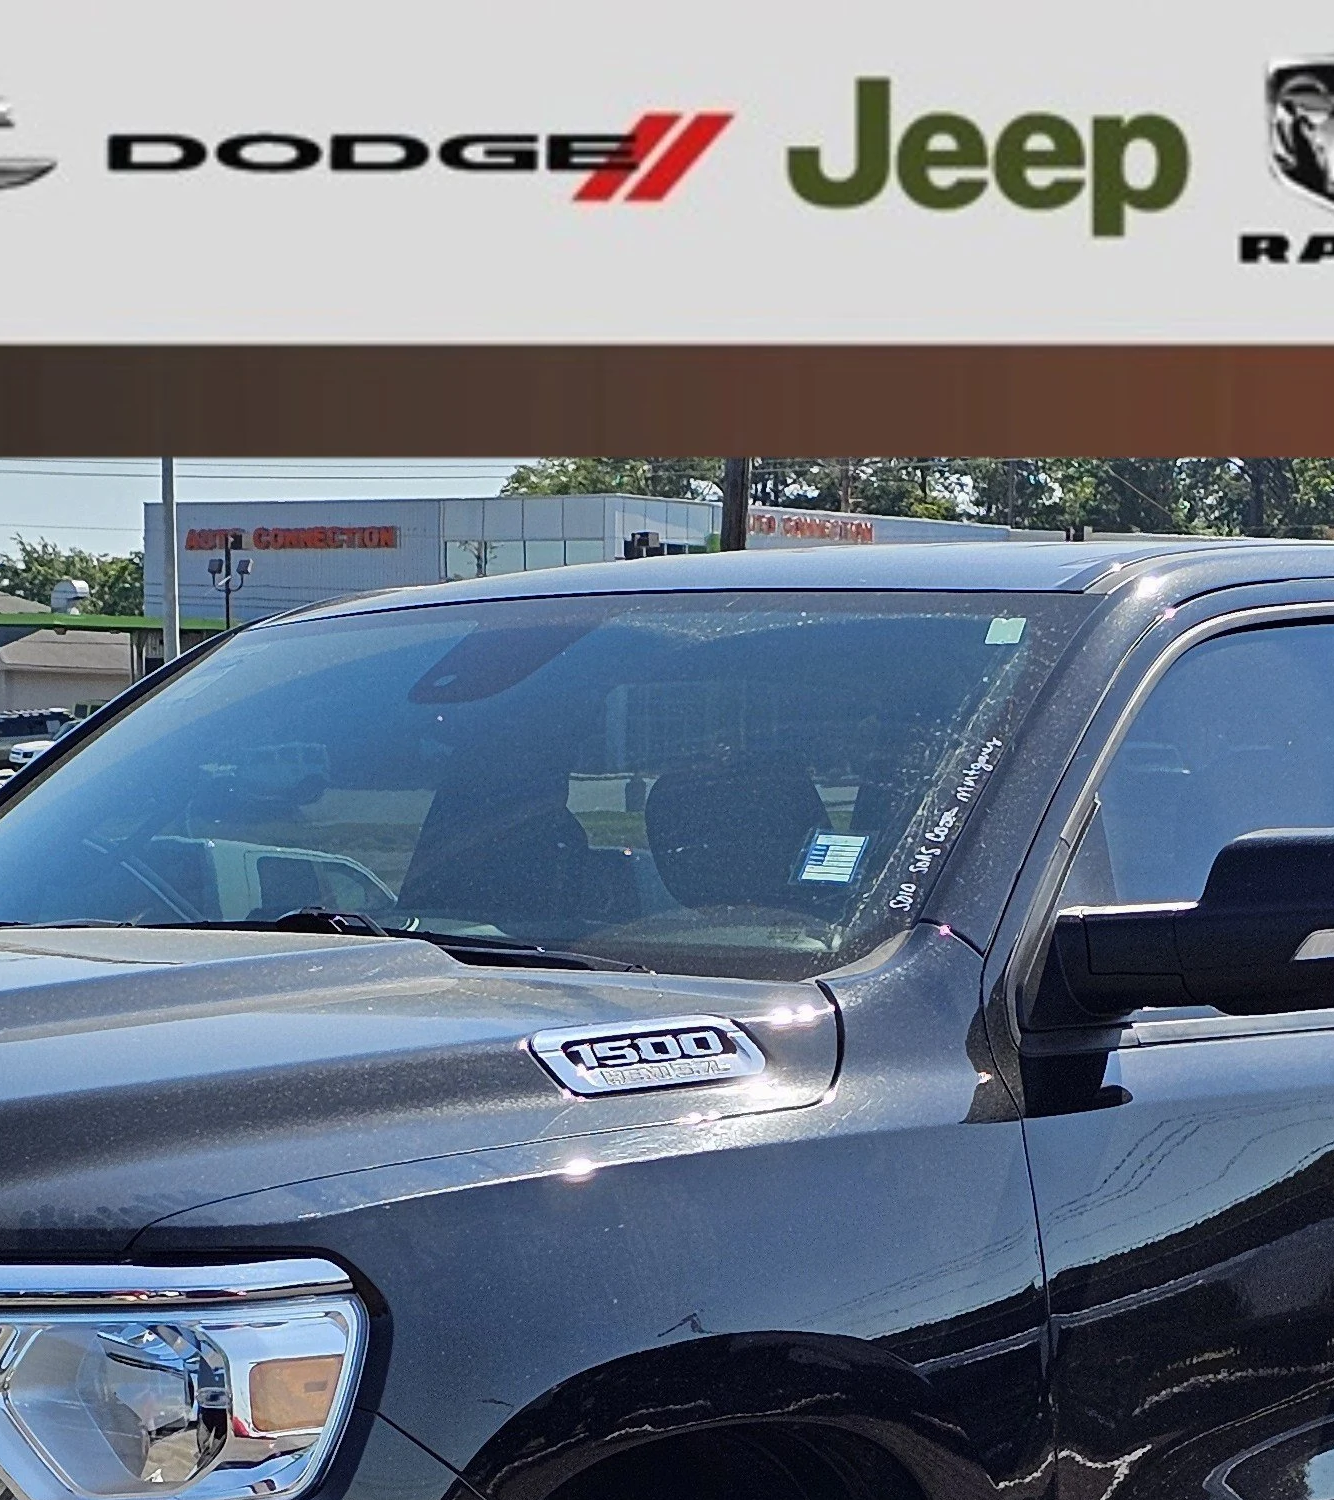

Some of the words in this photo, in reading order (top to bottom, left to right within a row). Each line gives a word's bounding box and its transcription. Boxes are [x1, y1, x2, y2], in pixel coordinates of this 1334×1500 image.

[253, 526, 399, 550] CONNECTION
[569, 1031, 723, 1068] 1500
[602, 1065, 672, 1086] HEMI
